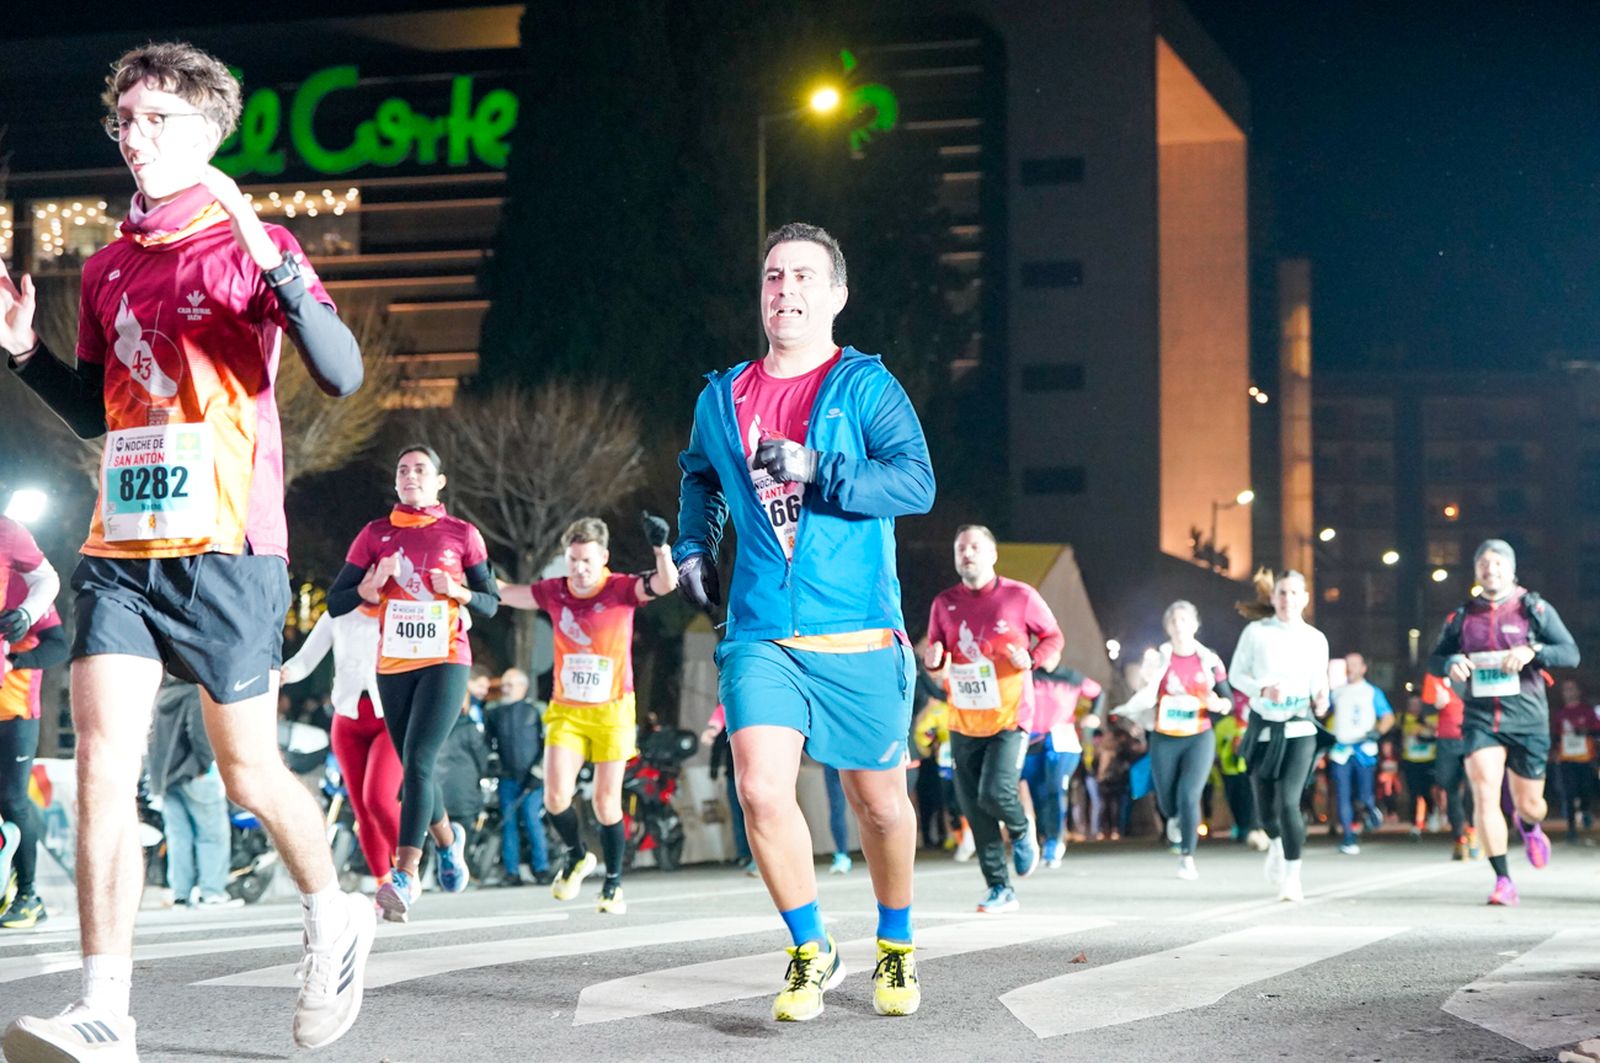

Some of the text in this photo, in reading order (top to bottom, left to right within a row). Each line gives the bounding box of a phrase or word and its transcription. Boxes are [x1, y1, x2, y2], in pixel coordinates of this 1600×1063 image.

[290, 64, 519, 174] Corte
[132, 351, 152, 381] 43
[125, 438, 164, 451] NOCHE DE
[113, 455, 132, 467] SAN
[120, 466, 188, 501] 8282
[406, 578, 421, 594] 43
[396, 621, 436, 638] 4008
[958, 680, 987, 694] 5031
